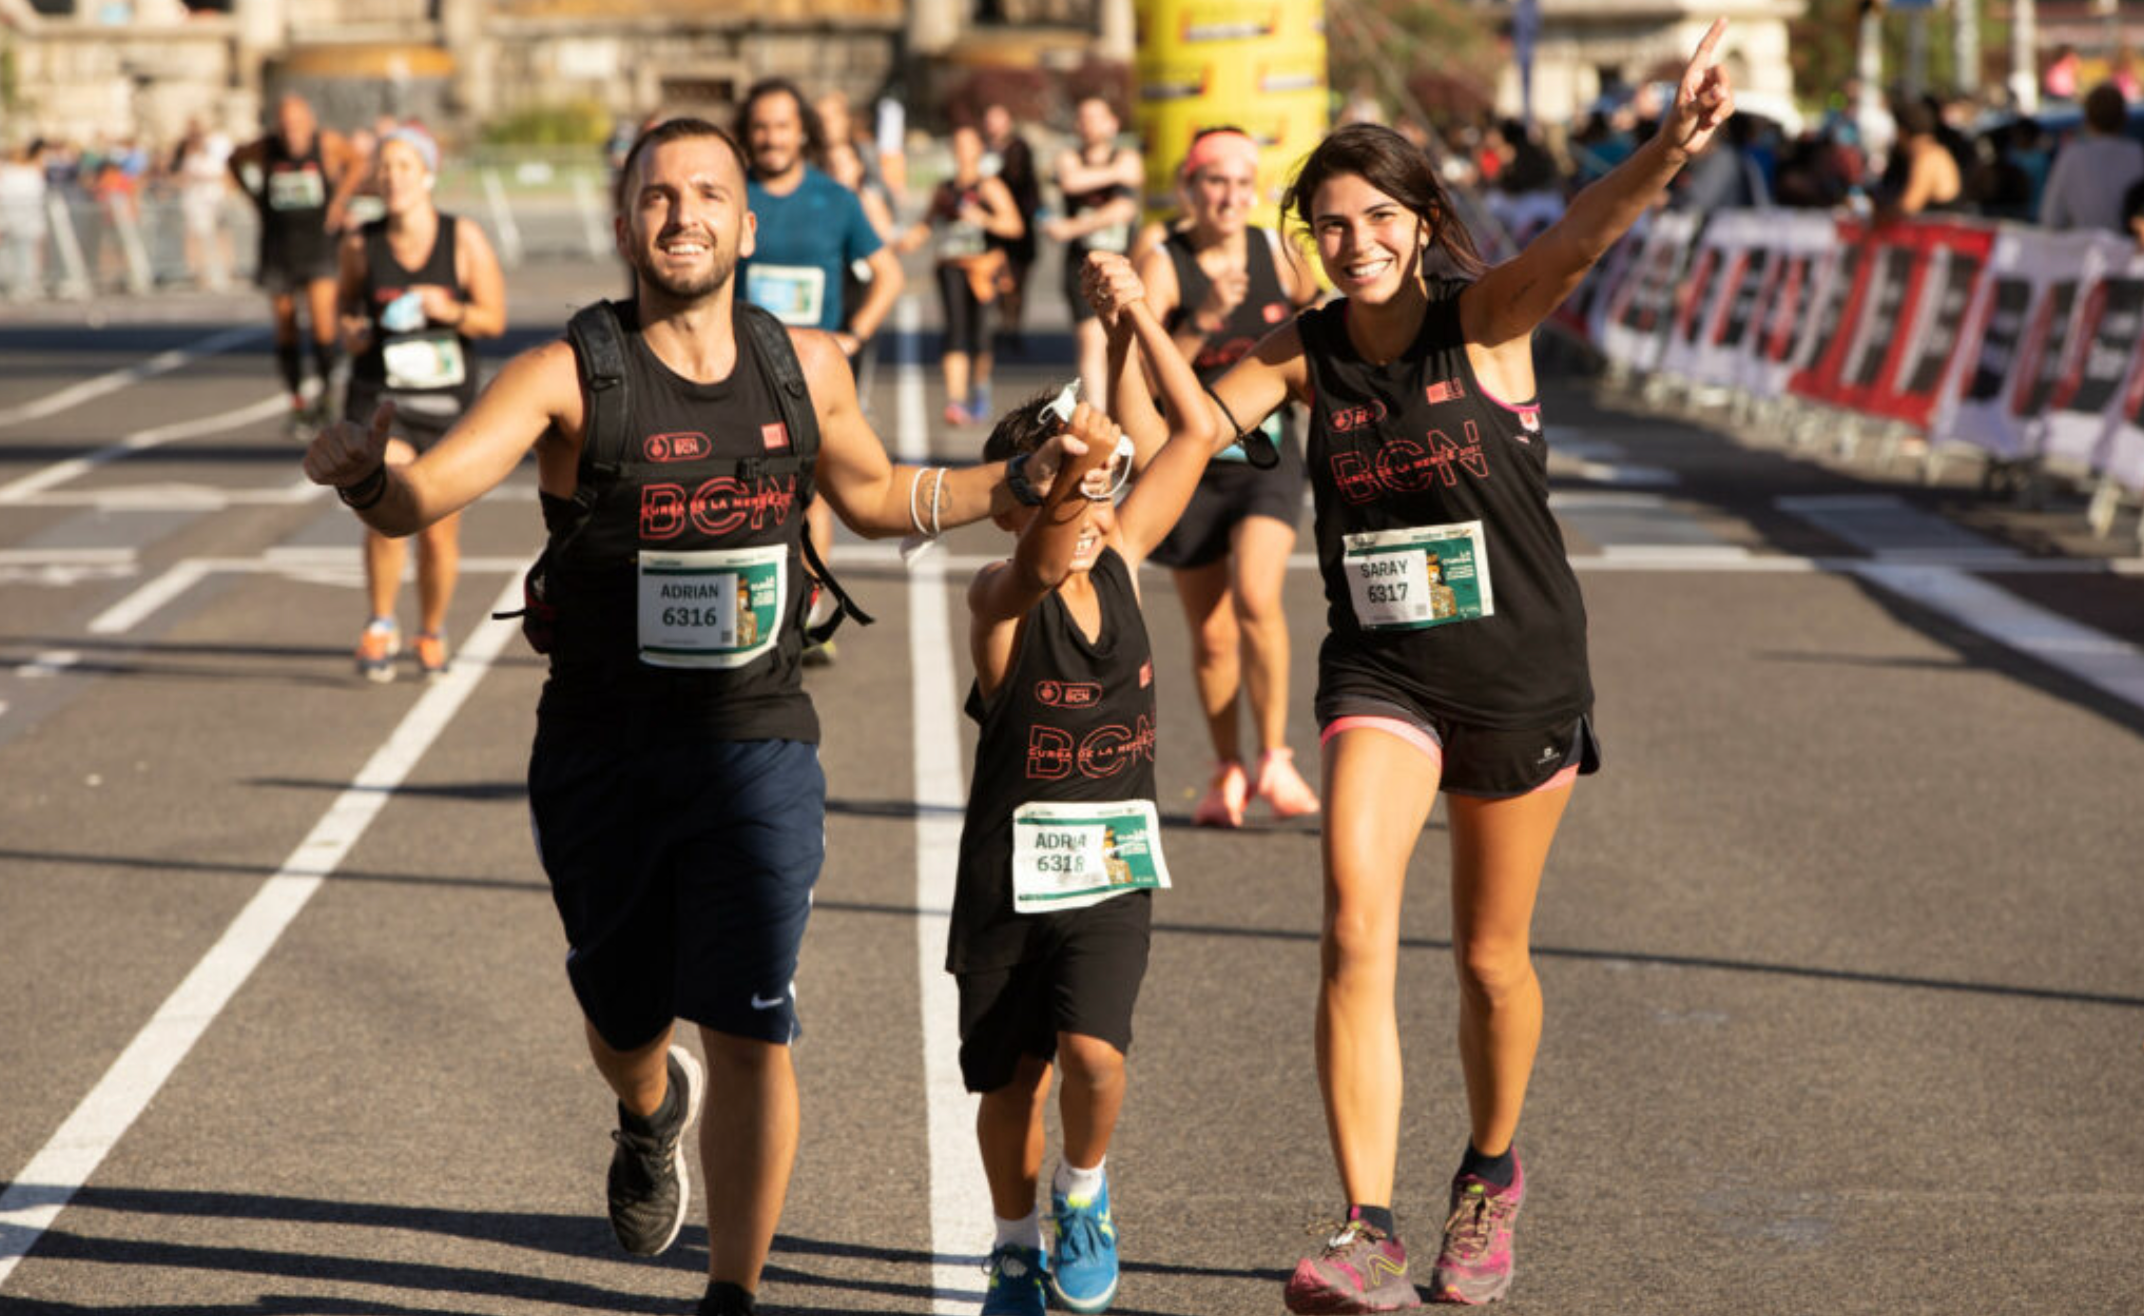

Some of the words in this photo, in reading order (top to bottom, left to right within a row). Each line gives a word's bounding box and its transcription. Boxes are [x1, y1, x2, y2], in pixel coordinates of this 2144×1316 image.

[1331, 420, 1488, 500] BCN
[639, 474, 796, 540] BCN
[711, 499, 728, 509] LA
[1360, 559, 1408, 578] SARAY
[661, 584, 718, 599] ADRIAN
[1368, 582, 1408, 603] 6317
[662, 607, 717, 627] 6316
[1097, 747, 1113, 757] LA
[1037, 854, 1085, 873] 6318
